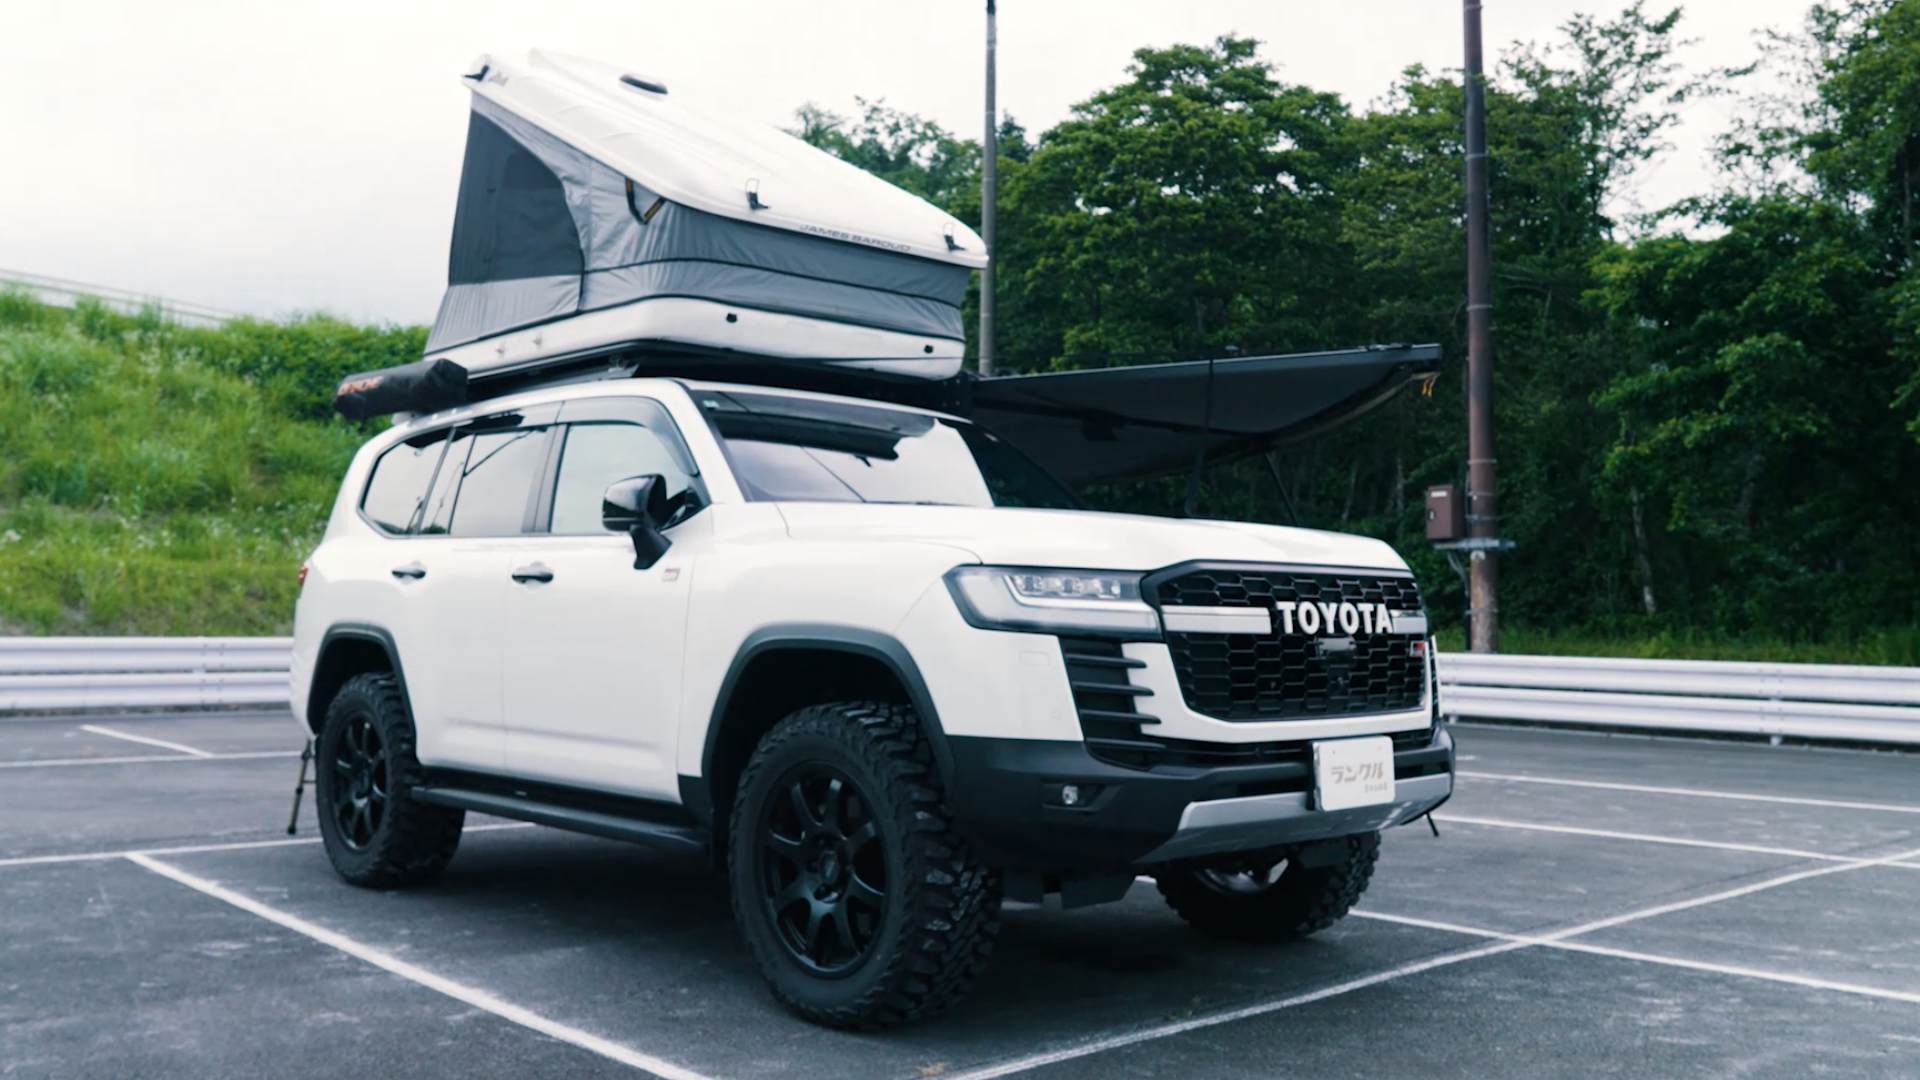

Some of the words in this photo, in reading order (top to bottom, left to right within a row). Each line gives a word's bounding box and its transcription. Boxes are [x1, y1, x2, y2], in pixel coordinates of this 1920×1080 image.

[800, 224, 849, 239] JAMES
[851, 235, 911, 251] BAROUD
[1276, 601, 1394, 635] TOYOTA
[1330, 762, 1384, 784] ランクル
